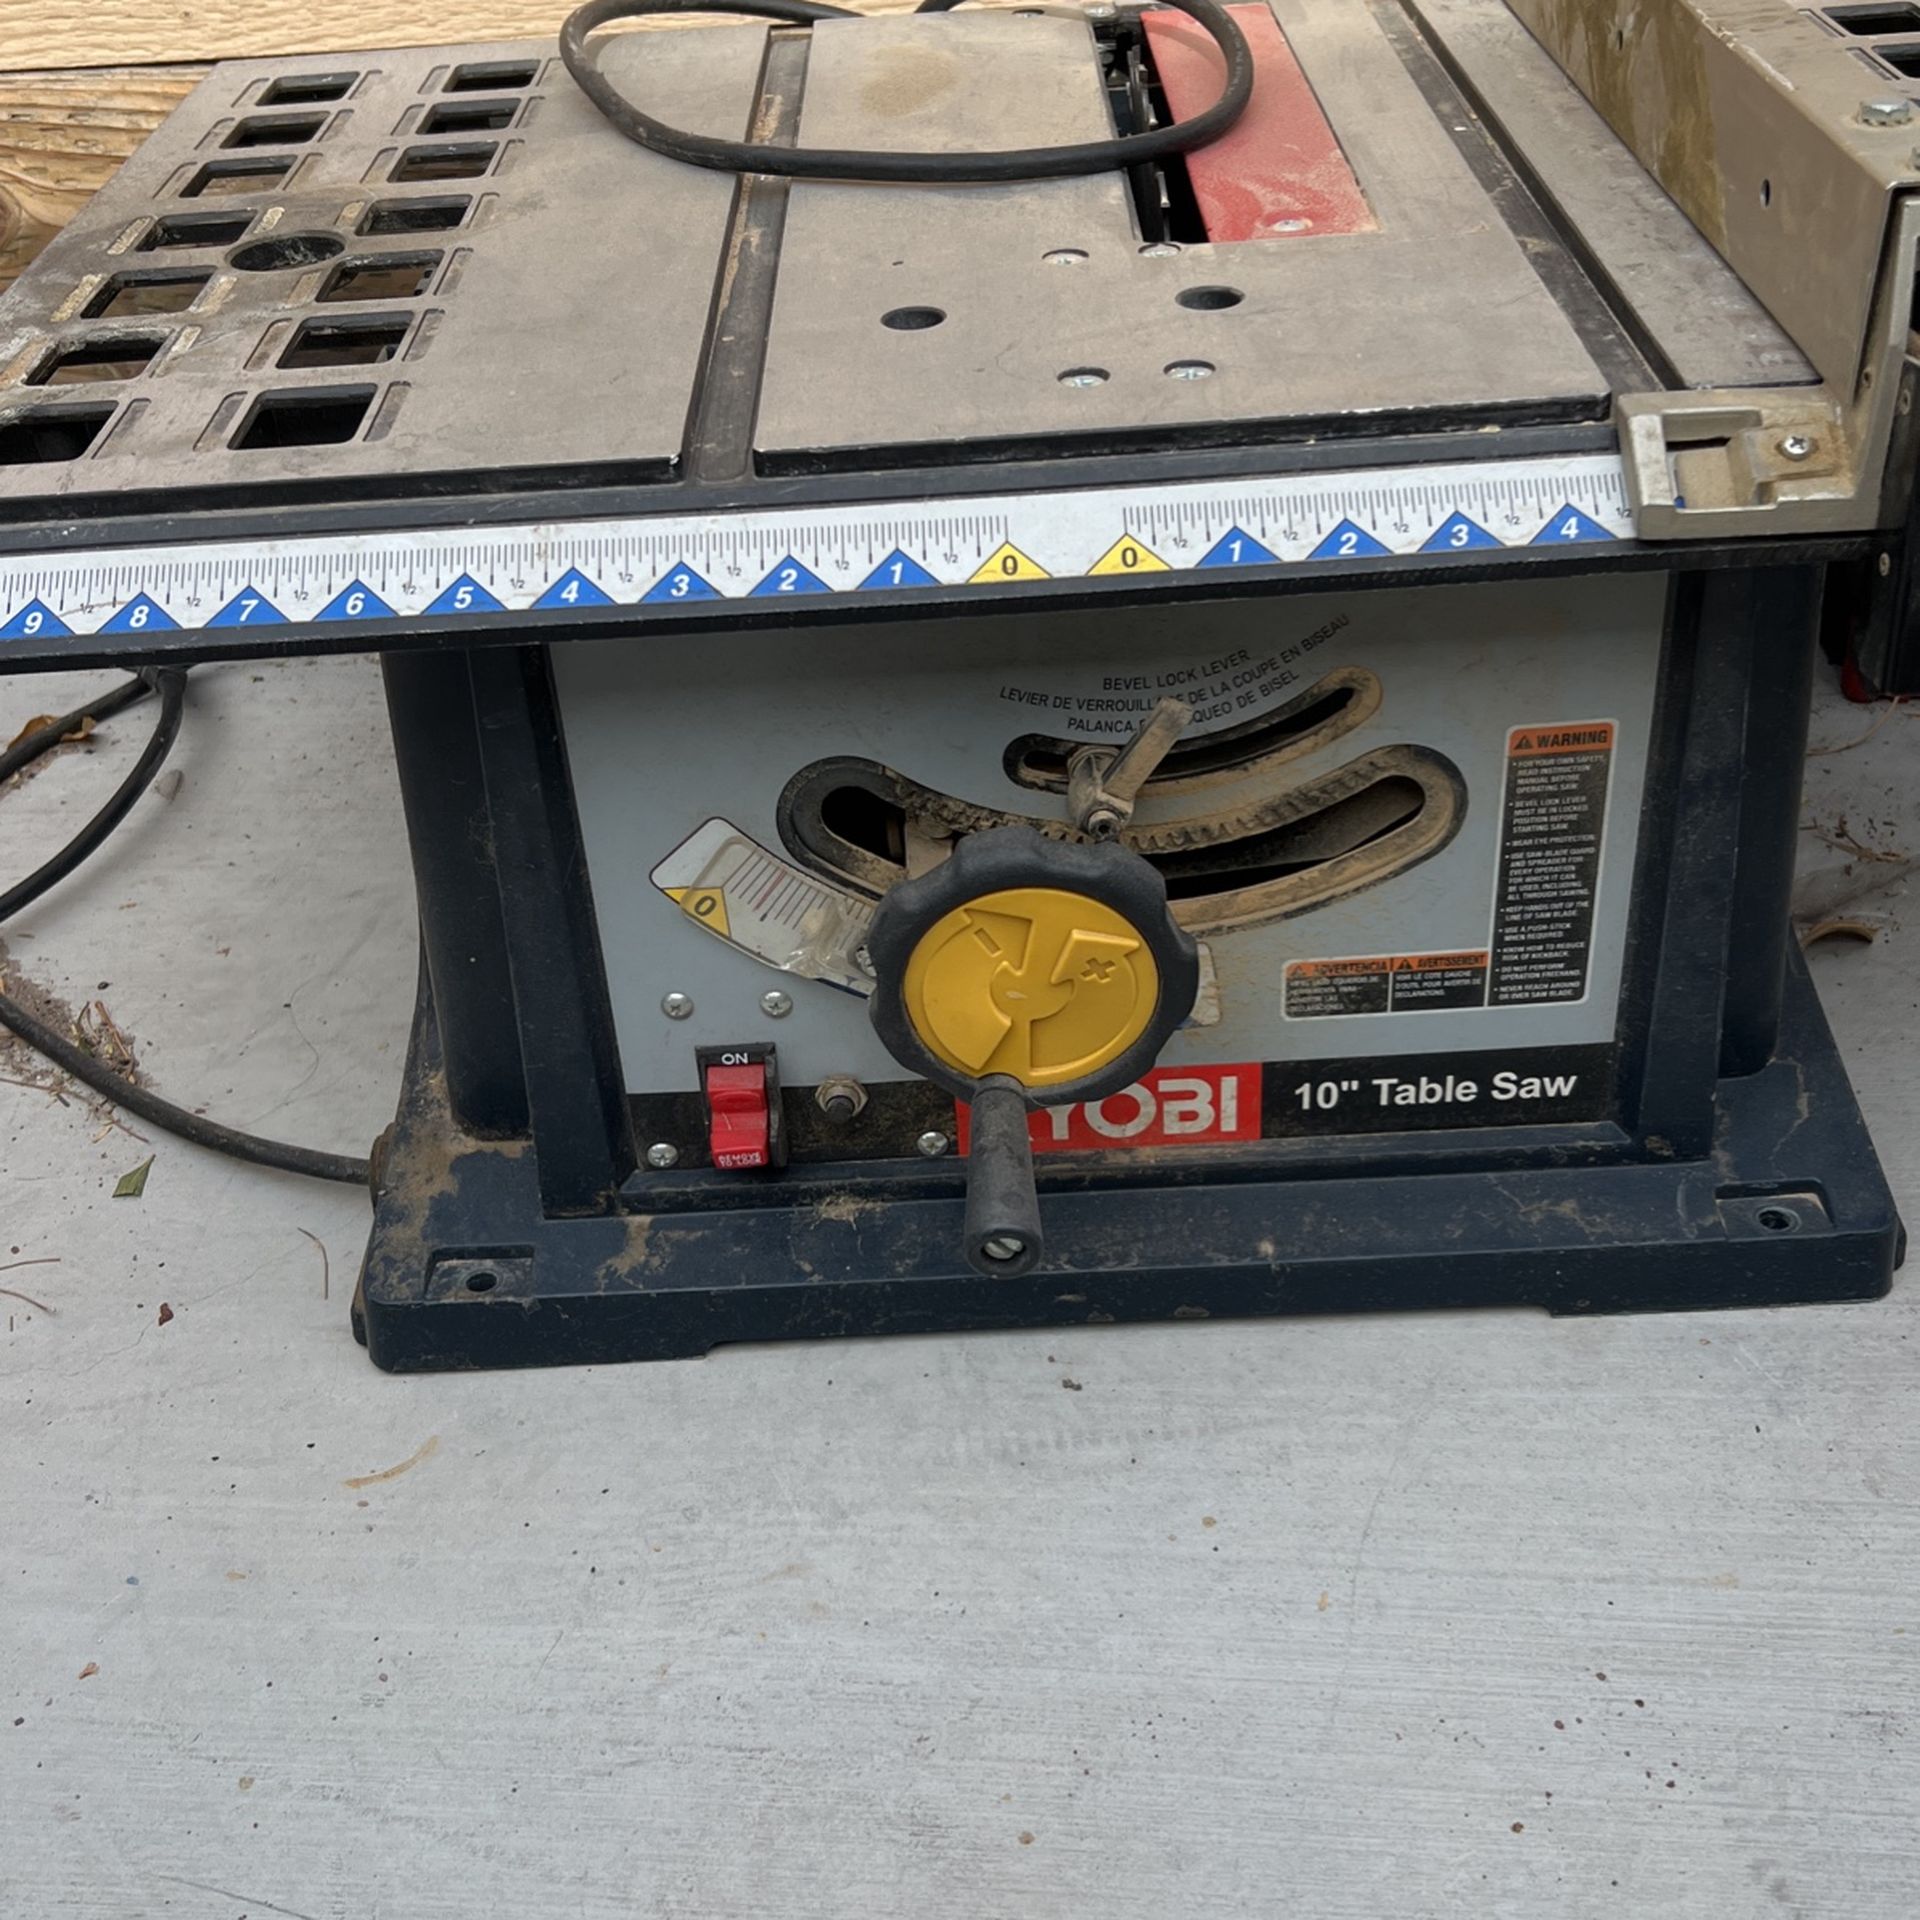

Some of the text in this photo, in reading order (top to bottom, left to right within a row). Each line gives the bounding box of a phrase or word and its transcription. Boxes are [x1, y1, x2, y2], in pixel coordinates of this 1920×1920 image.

[1121, 548, 1137, 568] 0
[1229, 542, 1241, 563] 1
[1340, 533, 1358, 554] 2
[1451, 525, 1470, 546] 3
[1560, 517, 1578, 538] 4
[24, 611, 43, 634] 9
[130, 606, 148, 628] 8
[240, 600, 258, 621] 7
[345, 594, 364, 615] 6
[454, 587, 472, 609] 5
[560, 581, 579, 602] 4
[671, 575, 689, 596] 3
[779, 570, 797, 591] 2
[890, 563, 902, 584] 1
[1002, 556, 1018, 576] 0
[1000, 686, 1049, 708] LEVIER
[1053, 696, 1072, 710] DE
[1189, 688, 1208, 704] DE
[1211, 680, 1231, 697] LA
[1234, 657, 1280, 688] COUPE
[1281, 645, 1301, 664] EN
[1301, 616, 1350, 652] BISEAU
[1103, 649, 1251, 691] BEVEL LOCK LEVER
[1068, 718, 1133, 733] PALANCA
[1237, 692, 1257, 708] DE
[1260, 669, 1299, 698] BISEL
[1537, 730, 1608, 748] WARNING
[694, 895, 716, 916] 0
[722, 1052, 748, 1065] ON
[1295, 1071, 1577, 1110] 10" Table Saw
